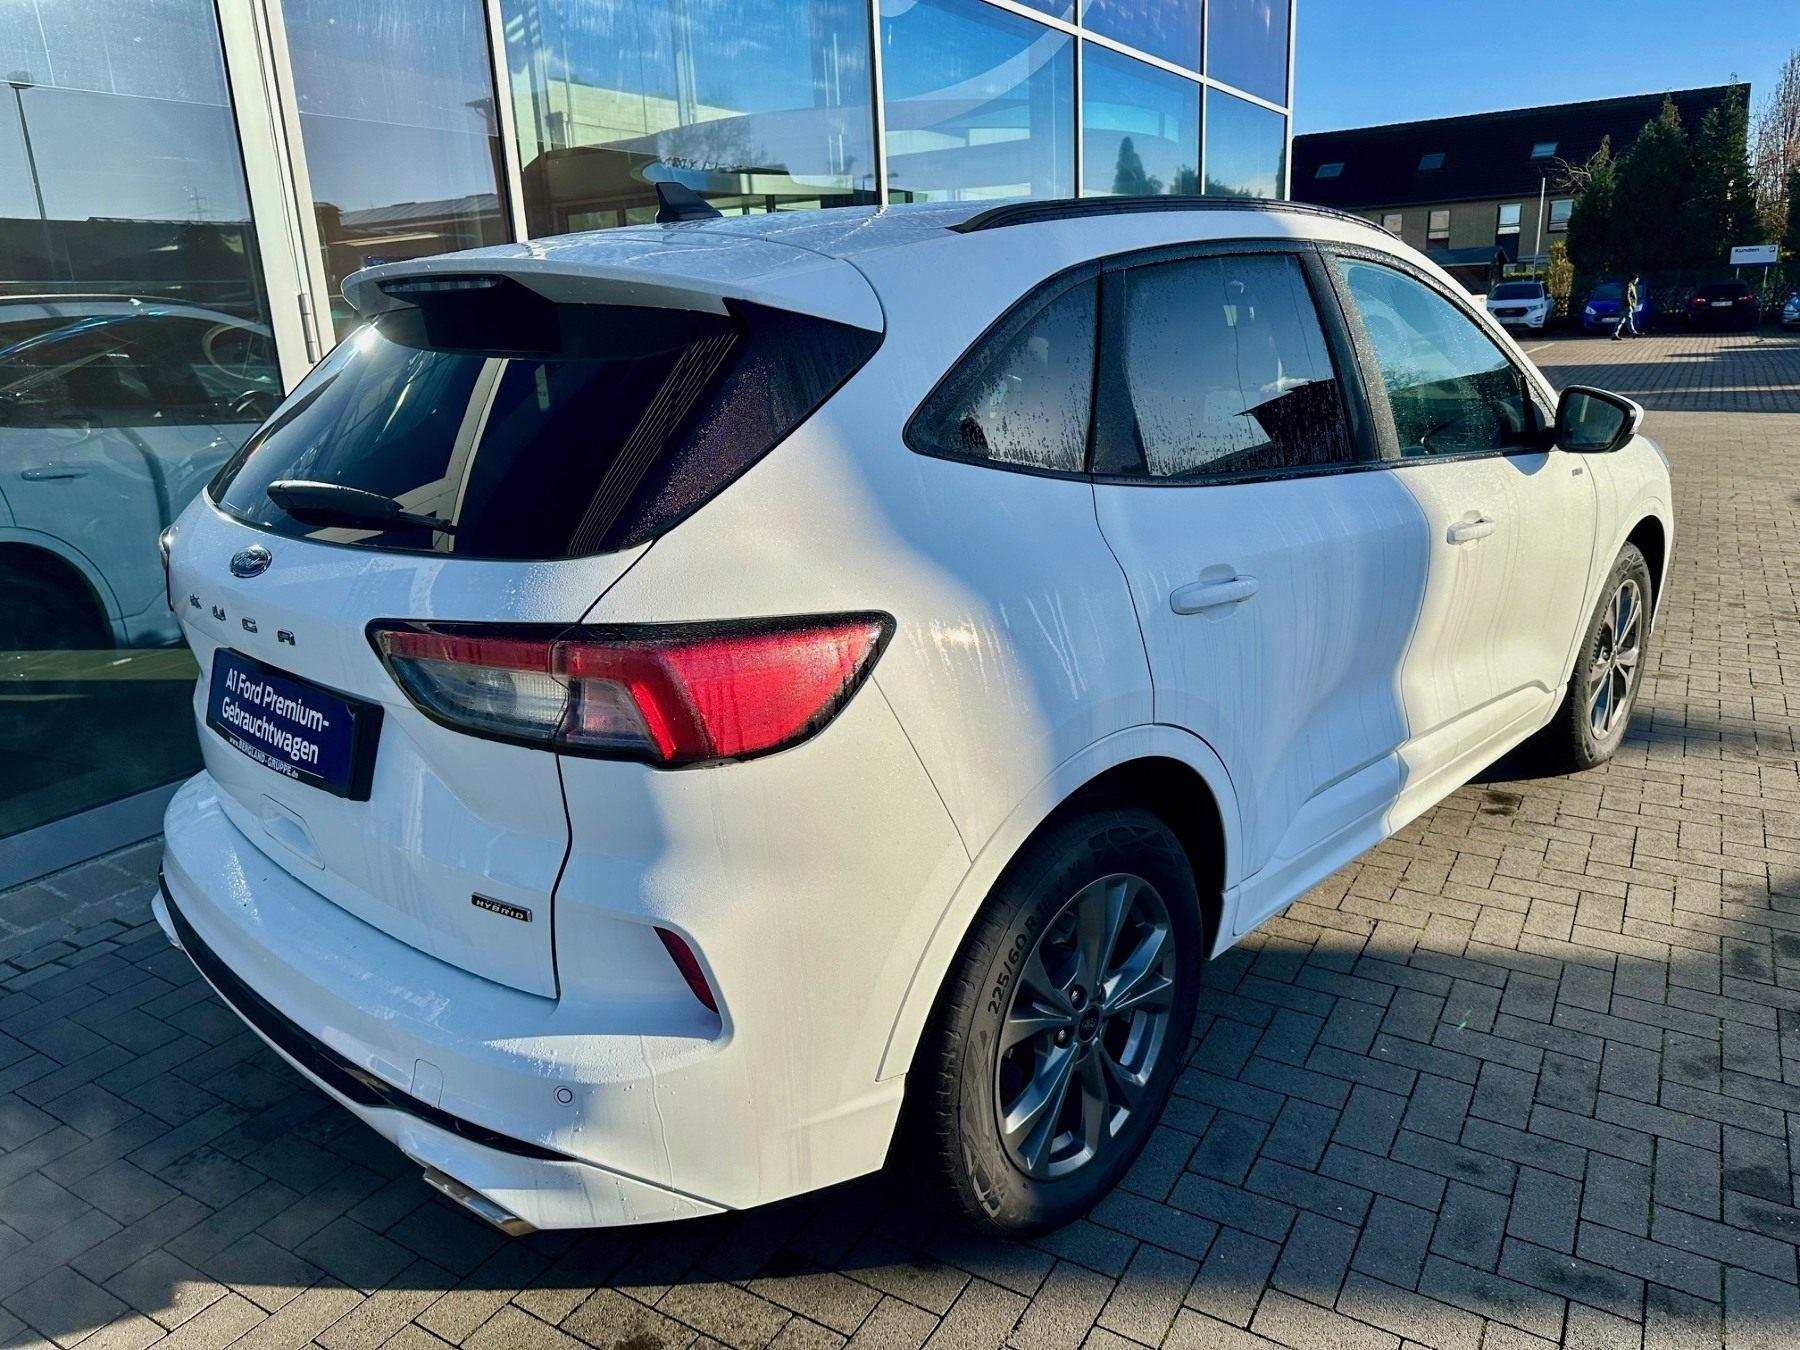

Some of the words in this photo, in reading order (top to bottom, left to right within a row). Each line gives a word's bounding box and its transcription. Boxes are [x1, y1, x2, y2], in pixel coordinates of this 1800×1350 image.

[189, 594, 296, 646] KUGA
[222, 696, 319, 765] Gebrauchtwagen
[225, 668, 238, 692] A1
[237, 673, 264, 705] Ford
[262, 685, 330, 732] Premium-
[476, 899, 524, 920] HYBRID
[988, 935, 1028, 1015] 225/60
